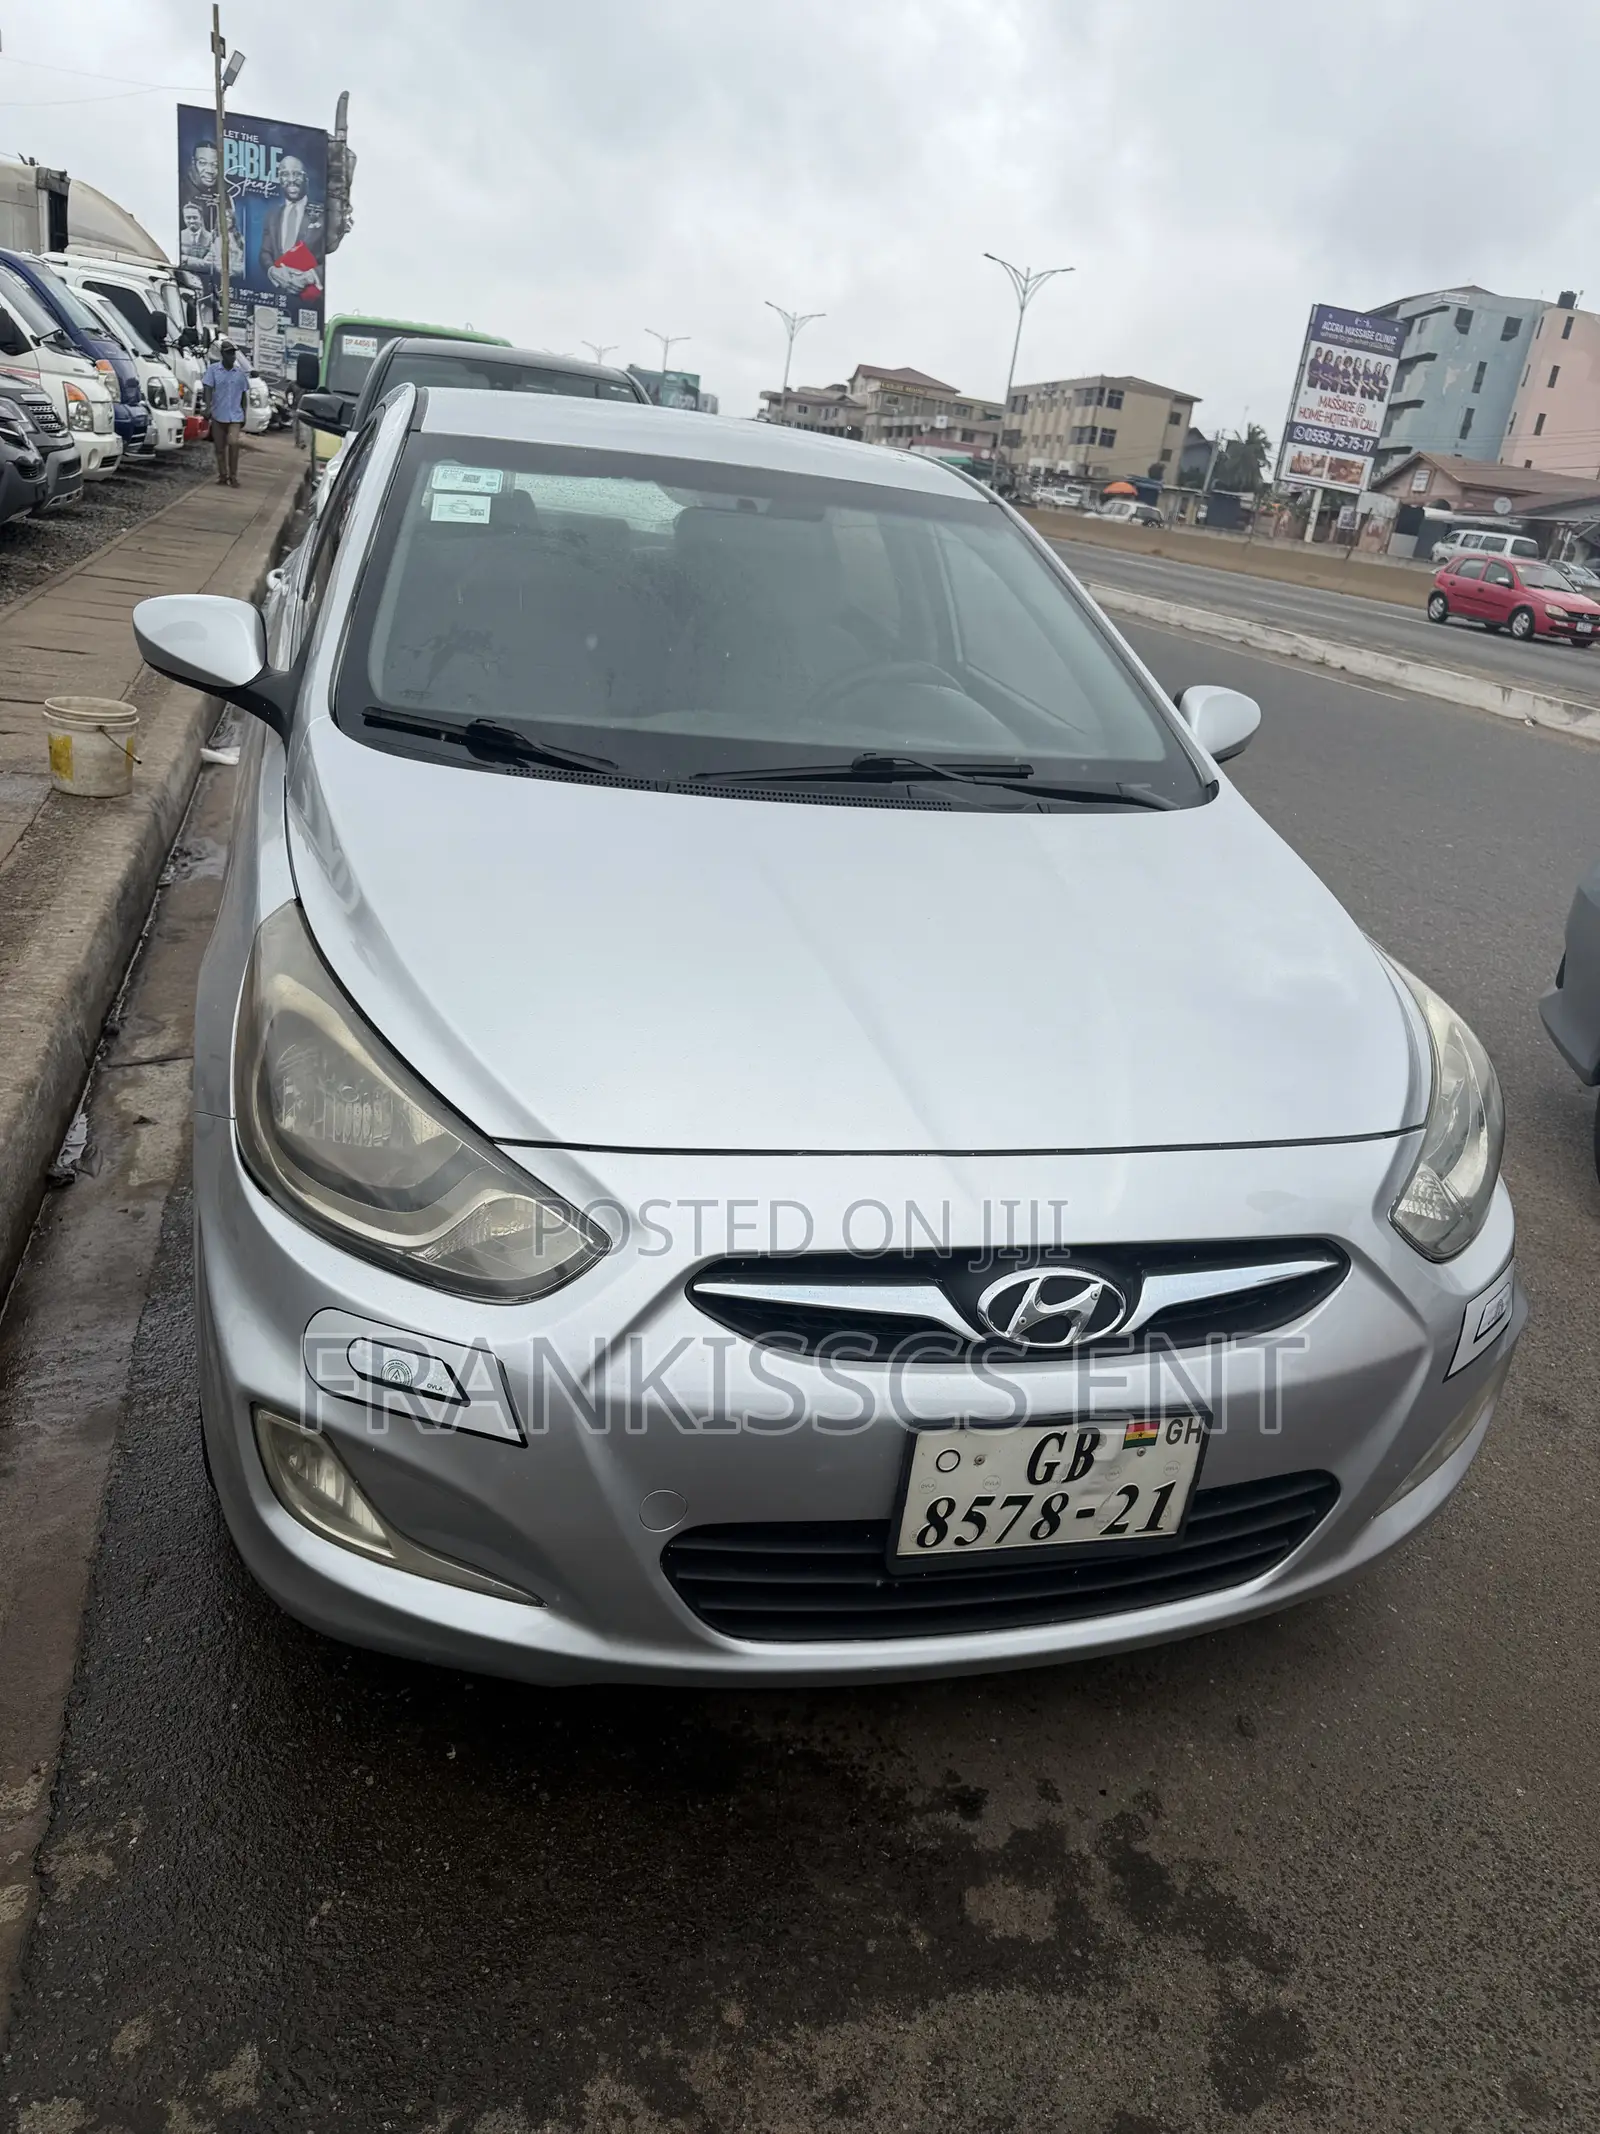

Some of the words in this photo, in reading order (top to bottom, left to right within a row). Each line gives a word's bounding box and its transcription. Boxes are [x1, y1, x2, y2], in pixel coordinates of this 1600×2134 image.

[223, 129, 240, 139] LET
[240, 132, 260, 143] THE
[223, 137, 284, 184] BIBLE
[223, 164, 277, 199] Speak
[1321, 320, 1344, 334] ACCRA
[1344, 325, 1376, 341] MASSAGE
[1375, 331, 1398, 346] CLINIC
[1317, 395, 1356, 414] MASSAGE
[1360, 418, 1378, 433] CALL
[1027, 1427, 1100, 1486] GB
[1165, 1418, 1201, 1446] GH
[916, 1480, 1177, 1549] 8578-21
